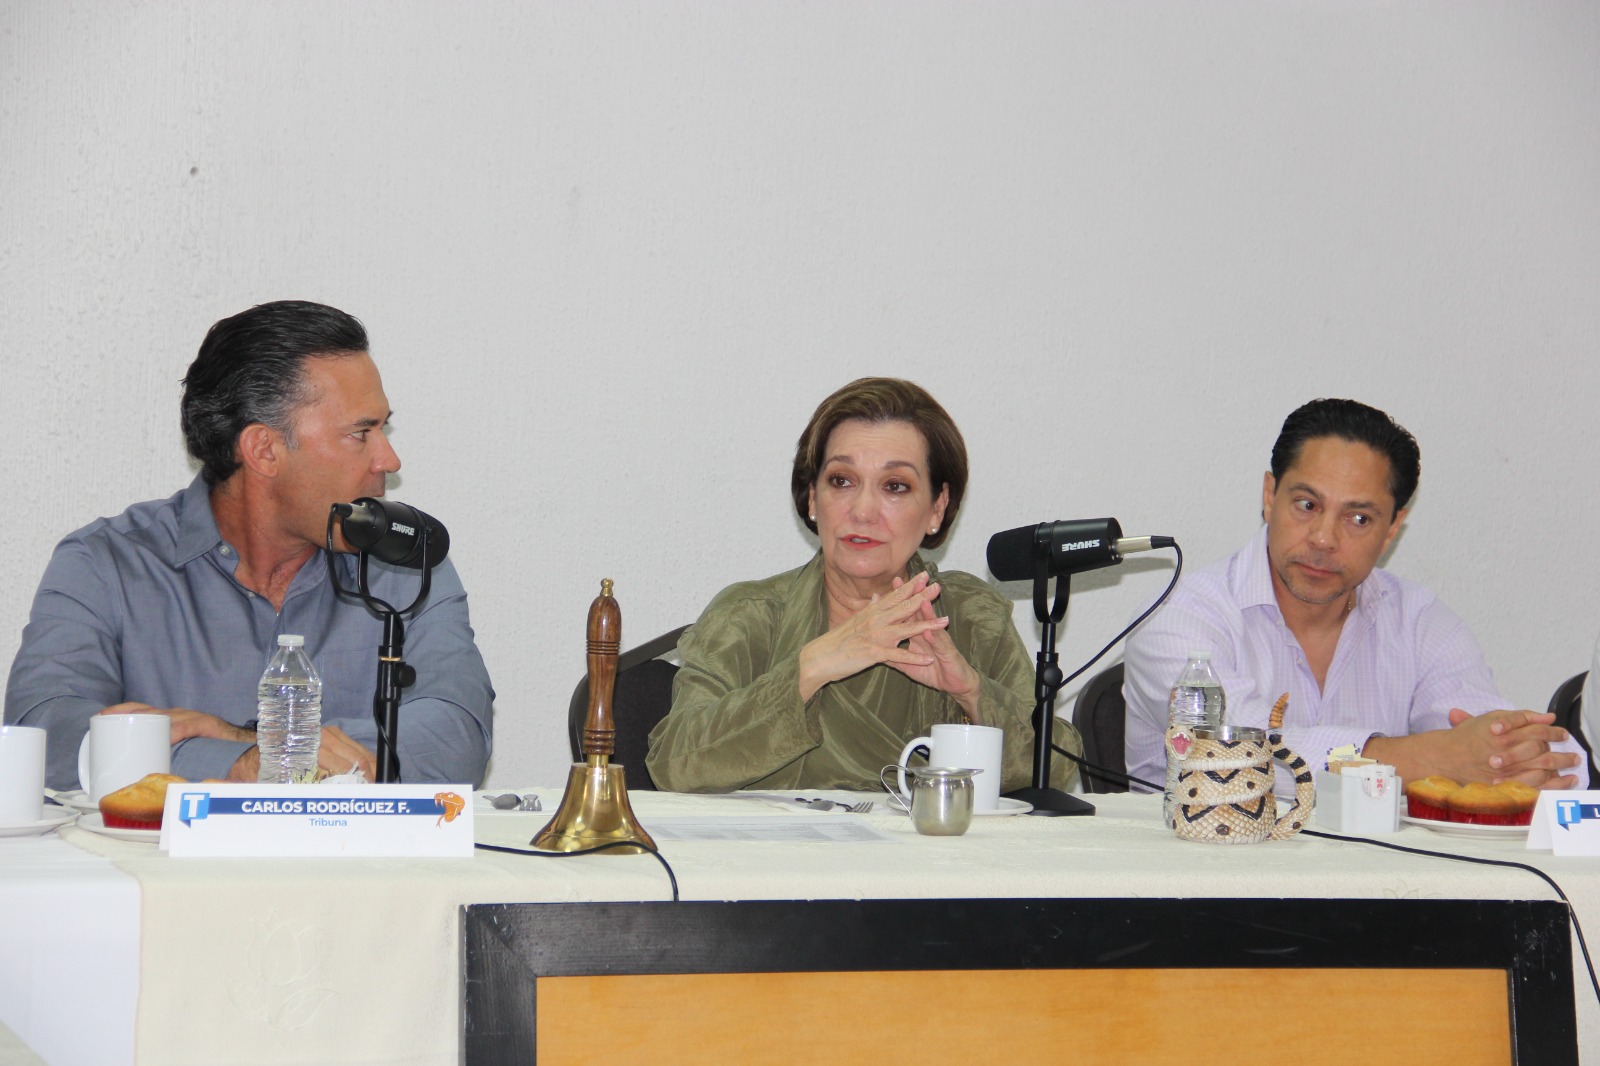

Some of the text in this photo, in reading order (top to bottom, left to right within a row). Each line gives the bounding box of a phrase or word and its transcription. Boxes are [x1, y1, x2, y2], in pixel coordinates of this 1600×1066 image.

[391, 522, 415, 536] SHURE
[1061, 539, 1100, 552] SHURE
[183, 794, 204, 818] T
[241, 798, 411, 814] CARLOS RODRÍGUEZ F.
[309, 817, 348, 827] Tribuna
